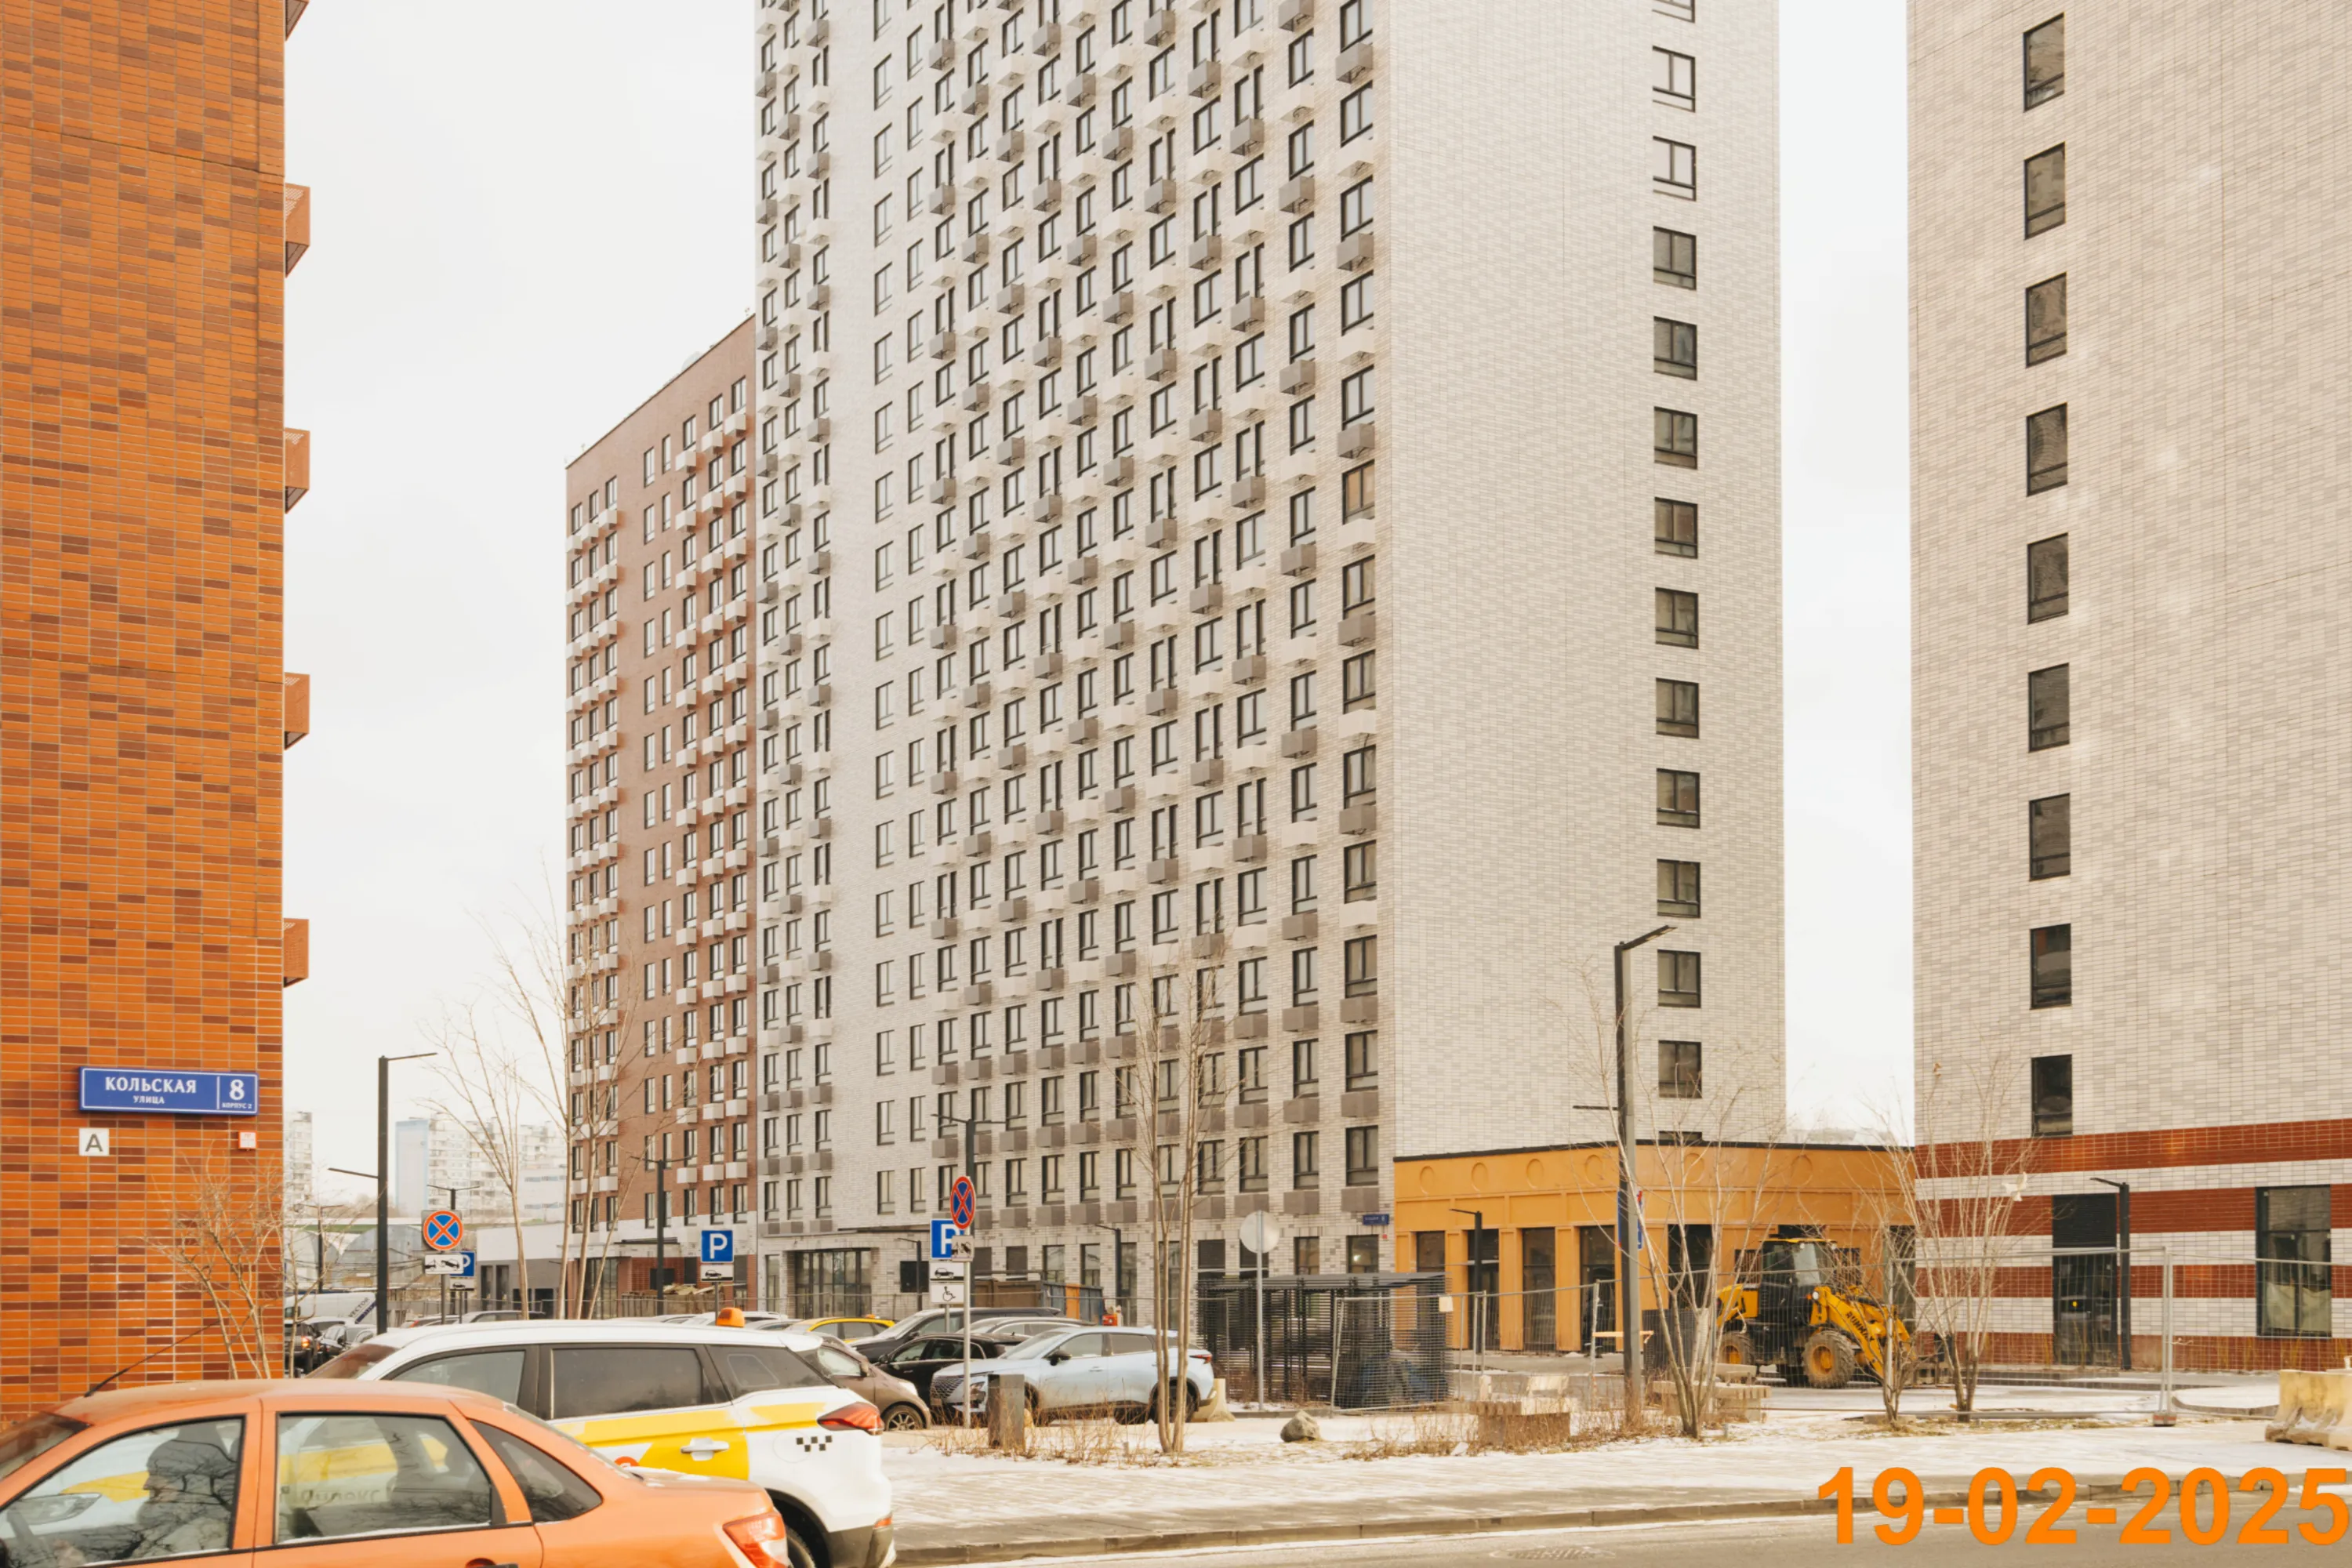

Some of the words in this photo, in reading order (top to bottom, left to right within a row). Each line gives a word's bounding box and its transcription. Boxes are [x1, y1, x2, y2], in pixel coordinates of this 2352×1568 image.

[105, 1076, 197, 1093] КОЛЬСКАЯ
[229, 1080, 245, 1100] 8
[132, 1095, 165, 1105] УЛИЦА
[710, 1232, 728, 1259] P
